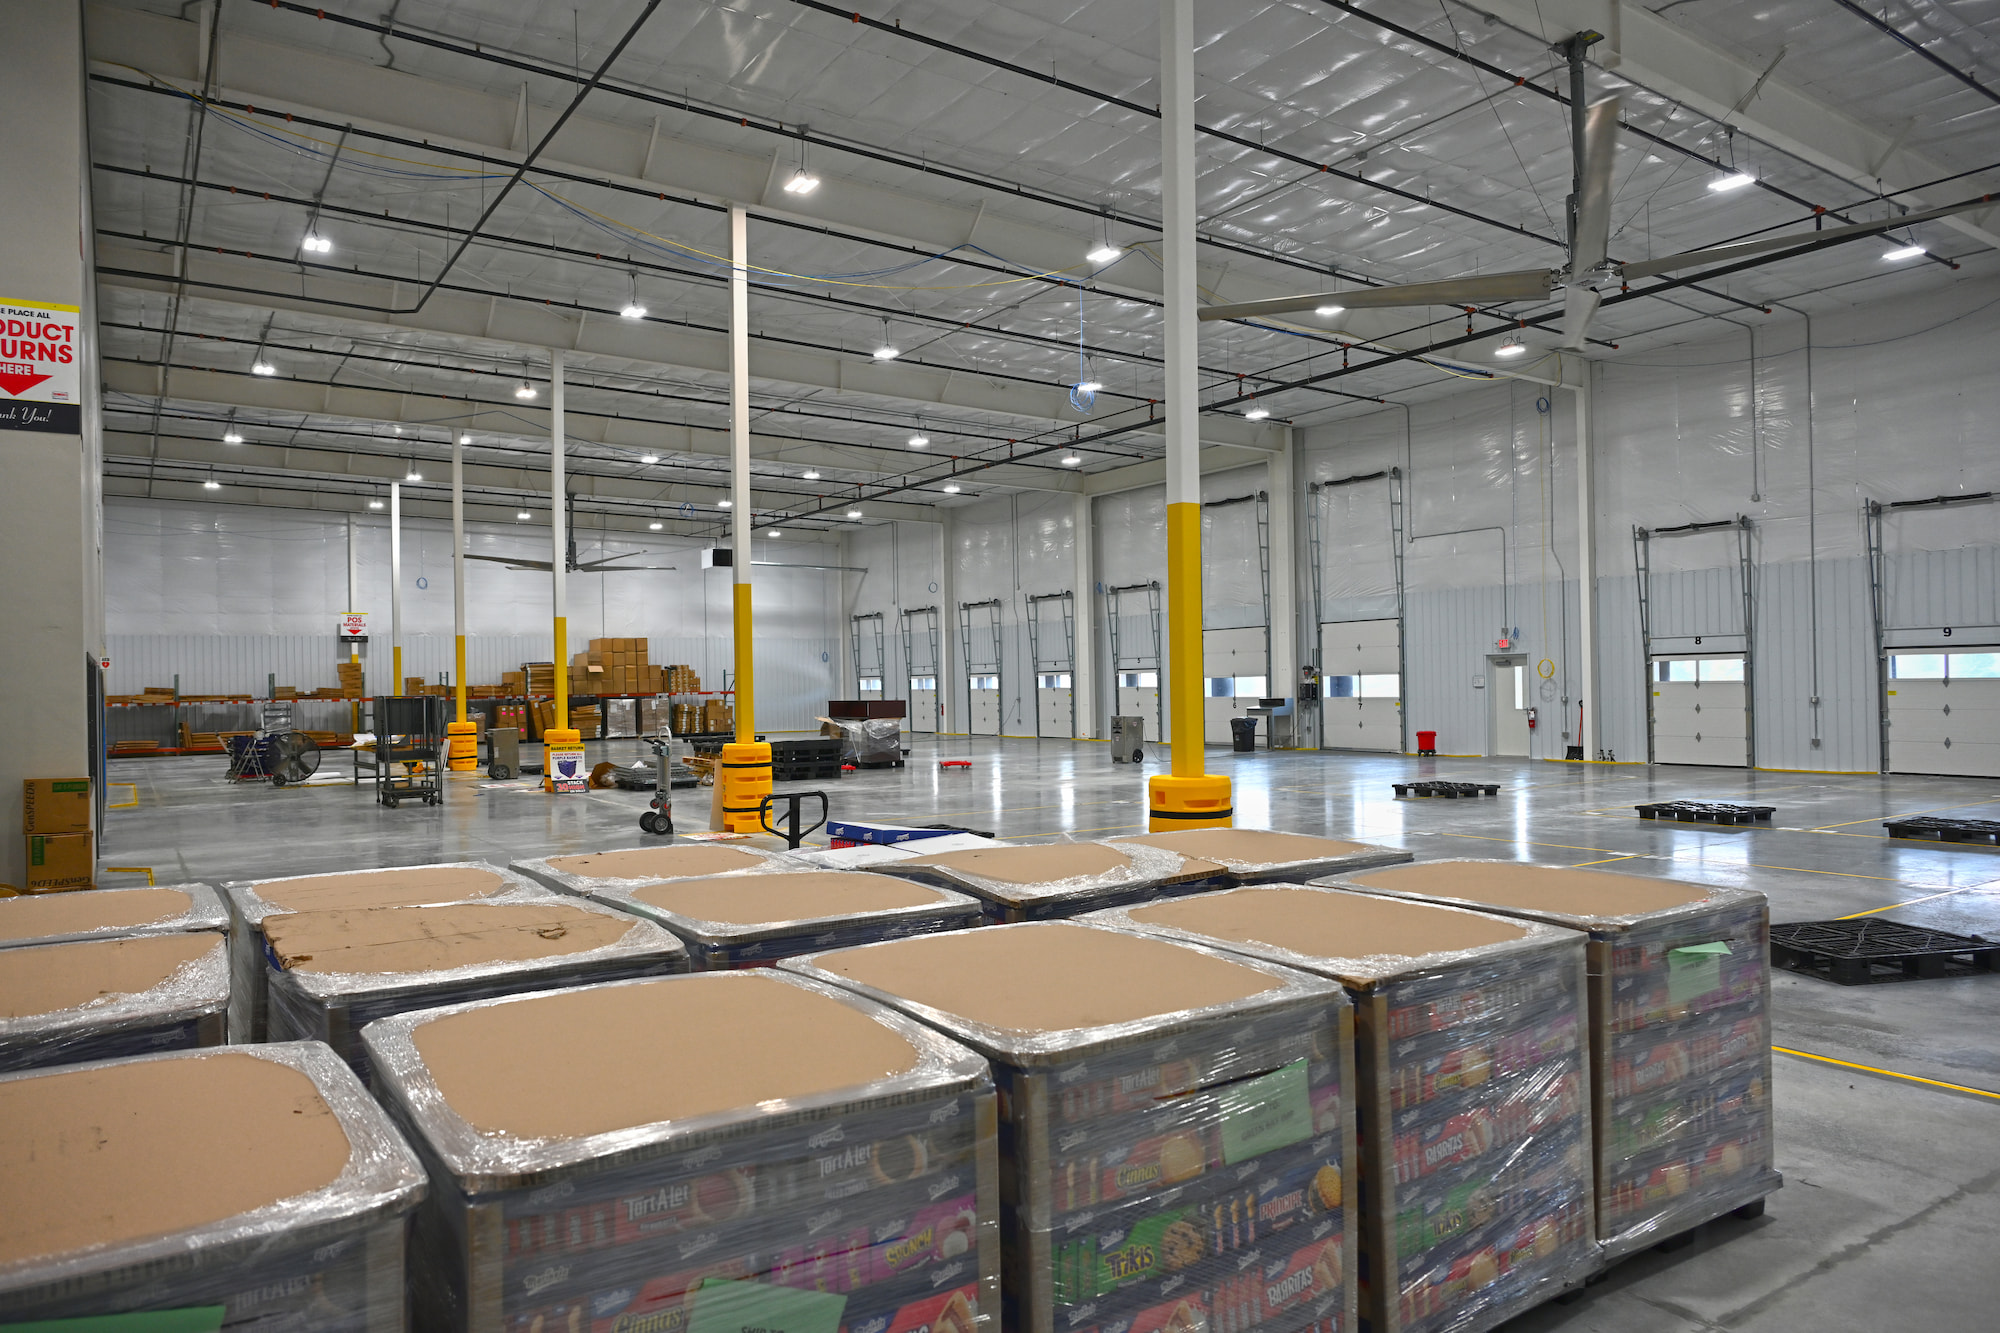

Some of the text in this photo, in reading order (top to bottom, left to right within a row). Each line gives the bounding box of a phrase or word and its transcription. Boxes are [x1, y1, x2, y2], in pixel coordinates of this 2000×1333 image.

[8, 309, 34, 317] PLACE
[0, 363, 31, 376] HERE
[21, 406, 52, 425] You!
[1943, 627, 1952, 637] 9
[1694, 637, 1701, 645] 8
[1358, 702, 1363, 710] 7
[556, 782, 569, 791] 30
[1115, 1162, 1161, 1189] Cinnas
